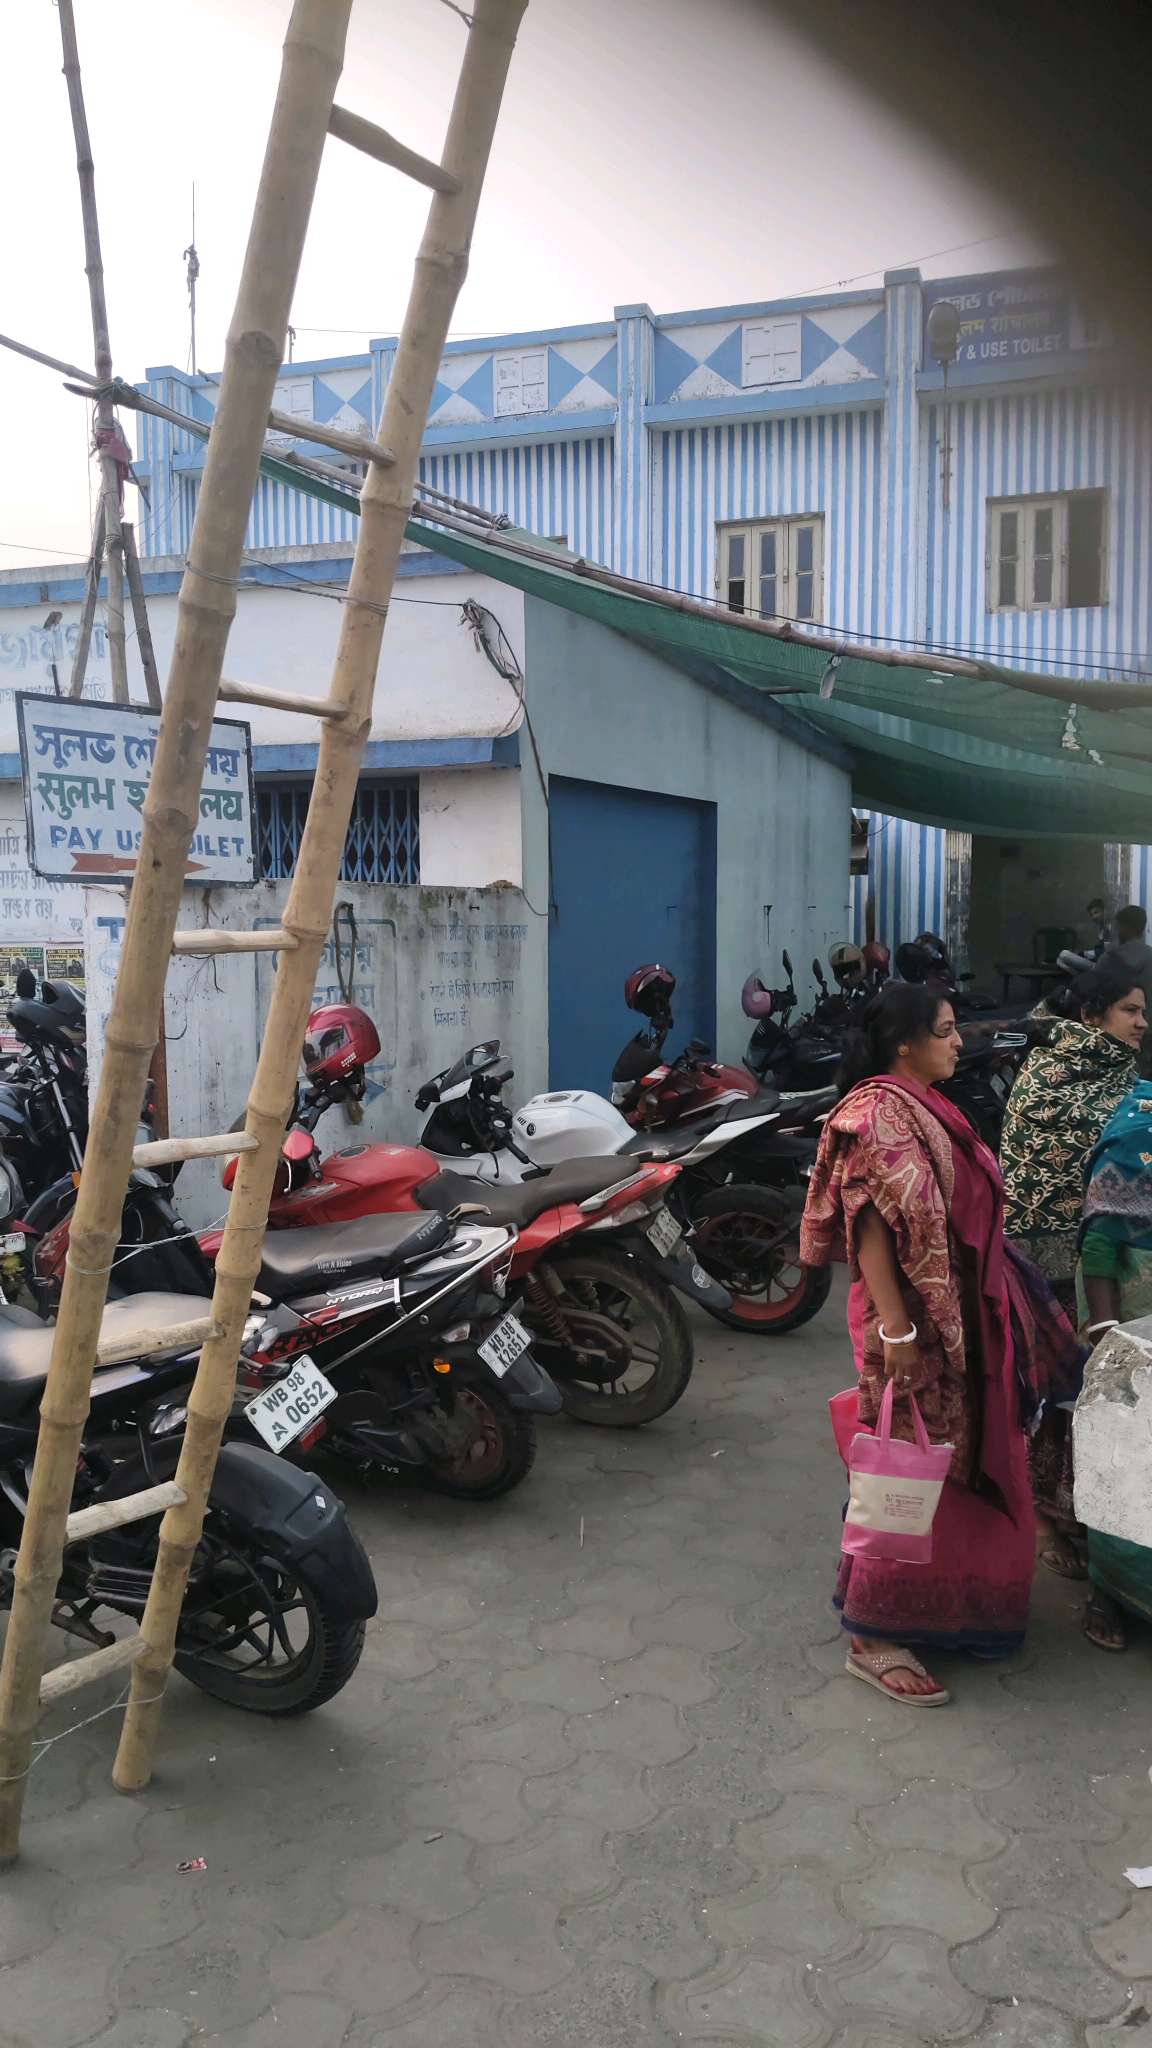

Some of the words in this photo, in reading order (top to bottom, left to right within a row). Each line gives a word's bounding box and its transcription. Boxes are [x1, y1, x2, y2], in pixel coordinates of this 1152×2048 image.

[980, 341, 1010, 360] USE
[1012, 334, 1064, 355] TOILET
[32, 724, 116, 768] সুলভ
[36, 772, 116, 821] सुलभ
[50, 825, 103, 850] PAY
[325, 1286, 384, 1306] NTORQ
[488, 1334, 505, 1354] WB
[500, 1321, 516, 1340] 98
[497, 1333, 527, 1368] K2651
[262, 1386, 289, 1414] WB
[287, 1371, 306, 1392] 98
[271, 1421, 289, 1442] A
[286, 1380, 329, 1425] 0652
